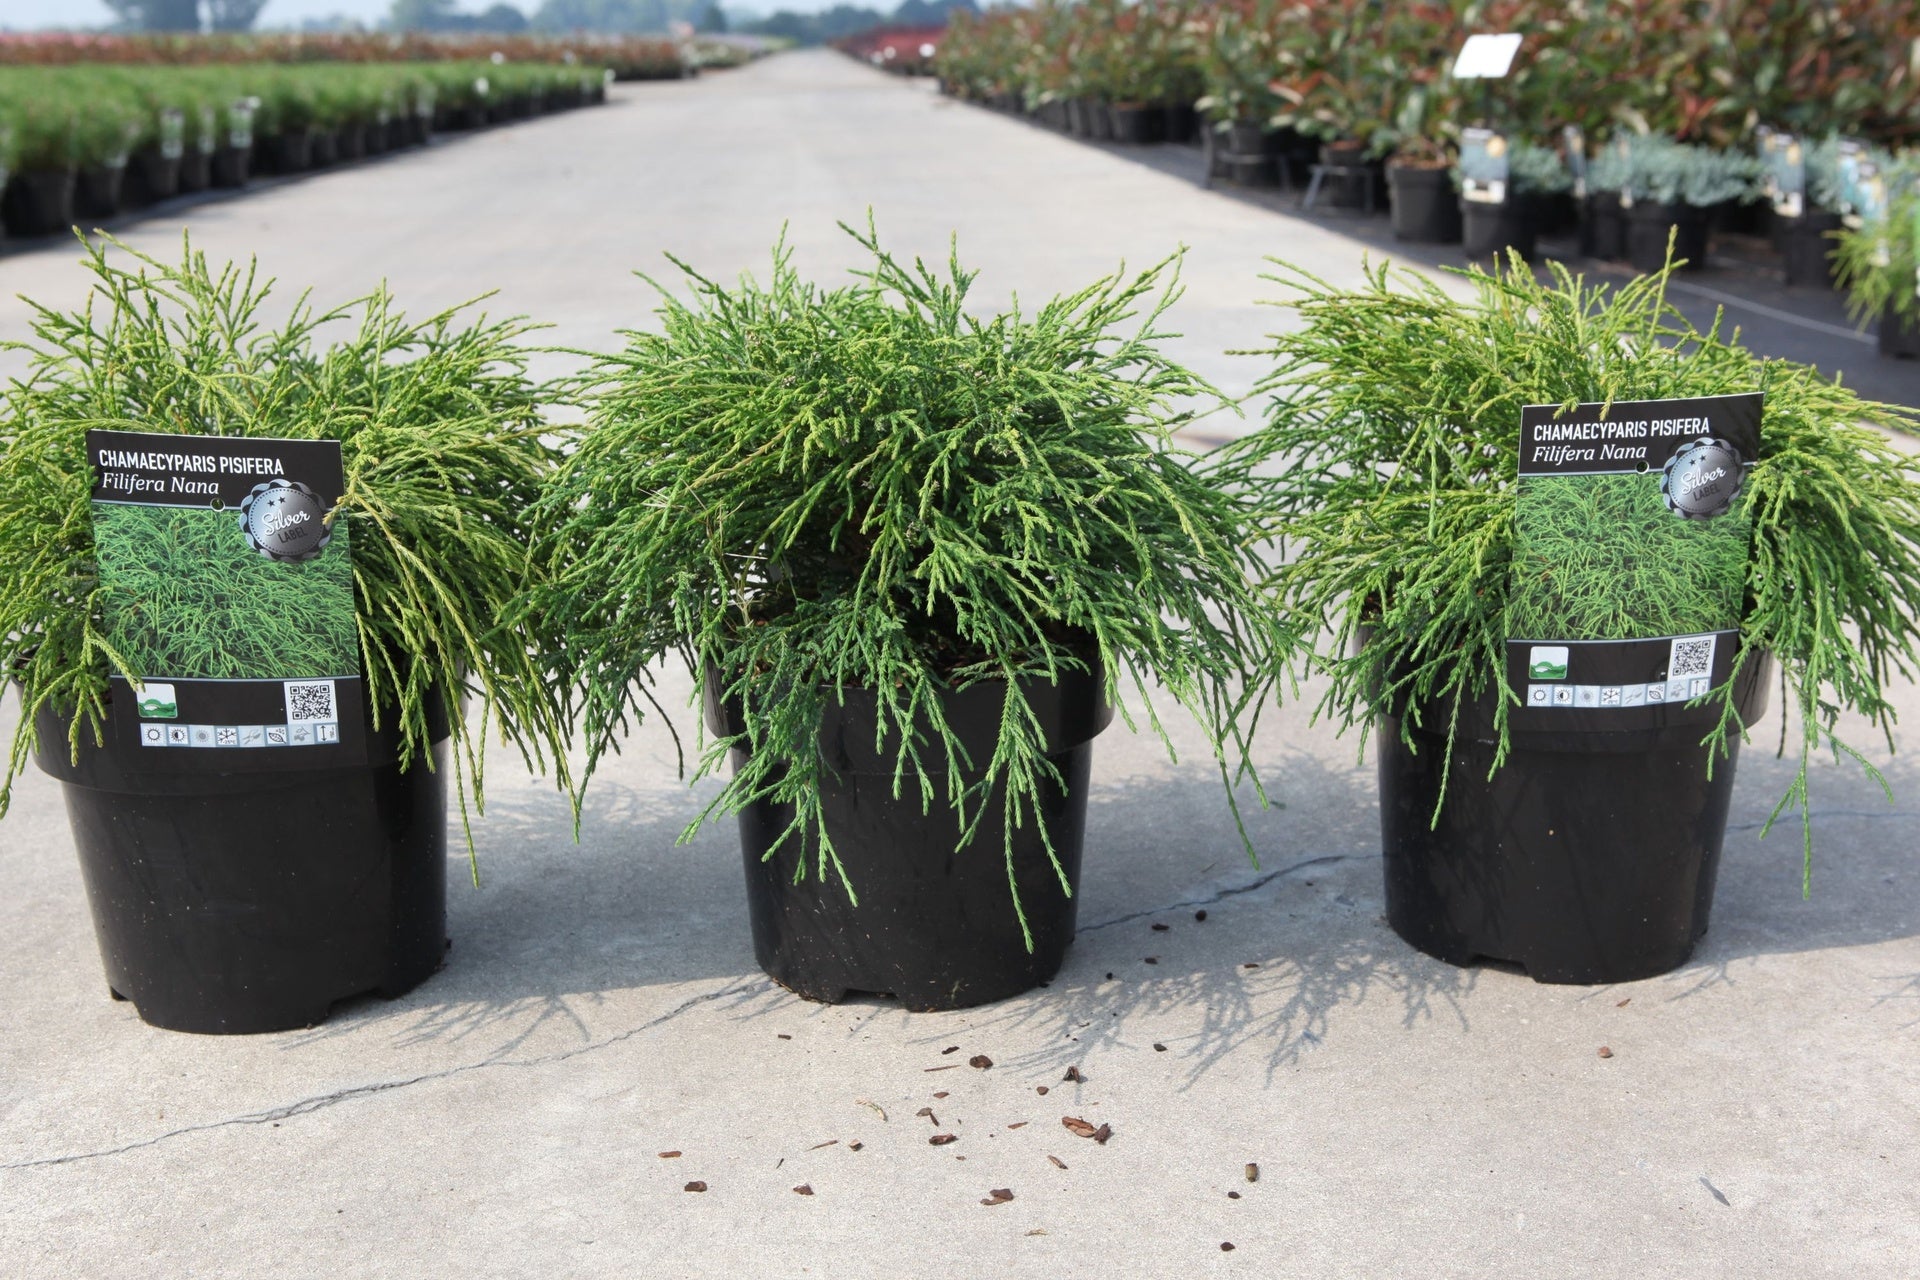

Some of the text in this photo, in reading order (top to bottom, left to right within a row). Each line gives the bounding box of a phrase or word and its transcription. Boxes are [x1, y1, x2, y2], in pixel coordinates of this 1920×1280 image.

[1533, 417, 1710, 441] CHAMAECYPARIS PISIFERA
[98, 449, 285, 475] CHAMAECYPARIS PISIFERA
[1532, 443, 1647, 466] Filifera Nana
[102, 473, 220, 495] Filifera Nana
[1681, 467, 1727, 495] Silver
[1693, 484, 1720, 502] LABEL
[261, 511, 311, 536] Silver
[278, 526, 309, 544] LABEL
